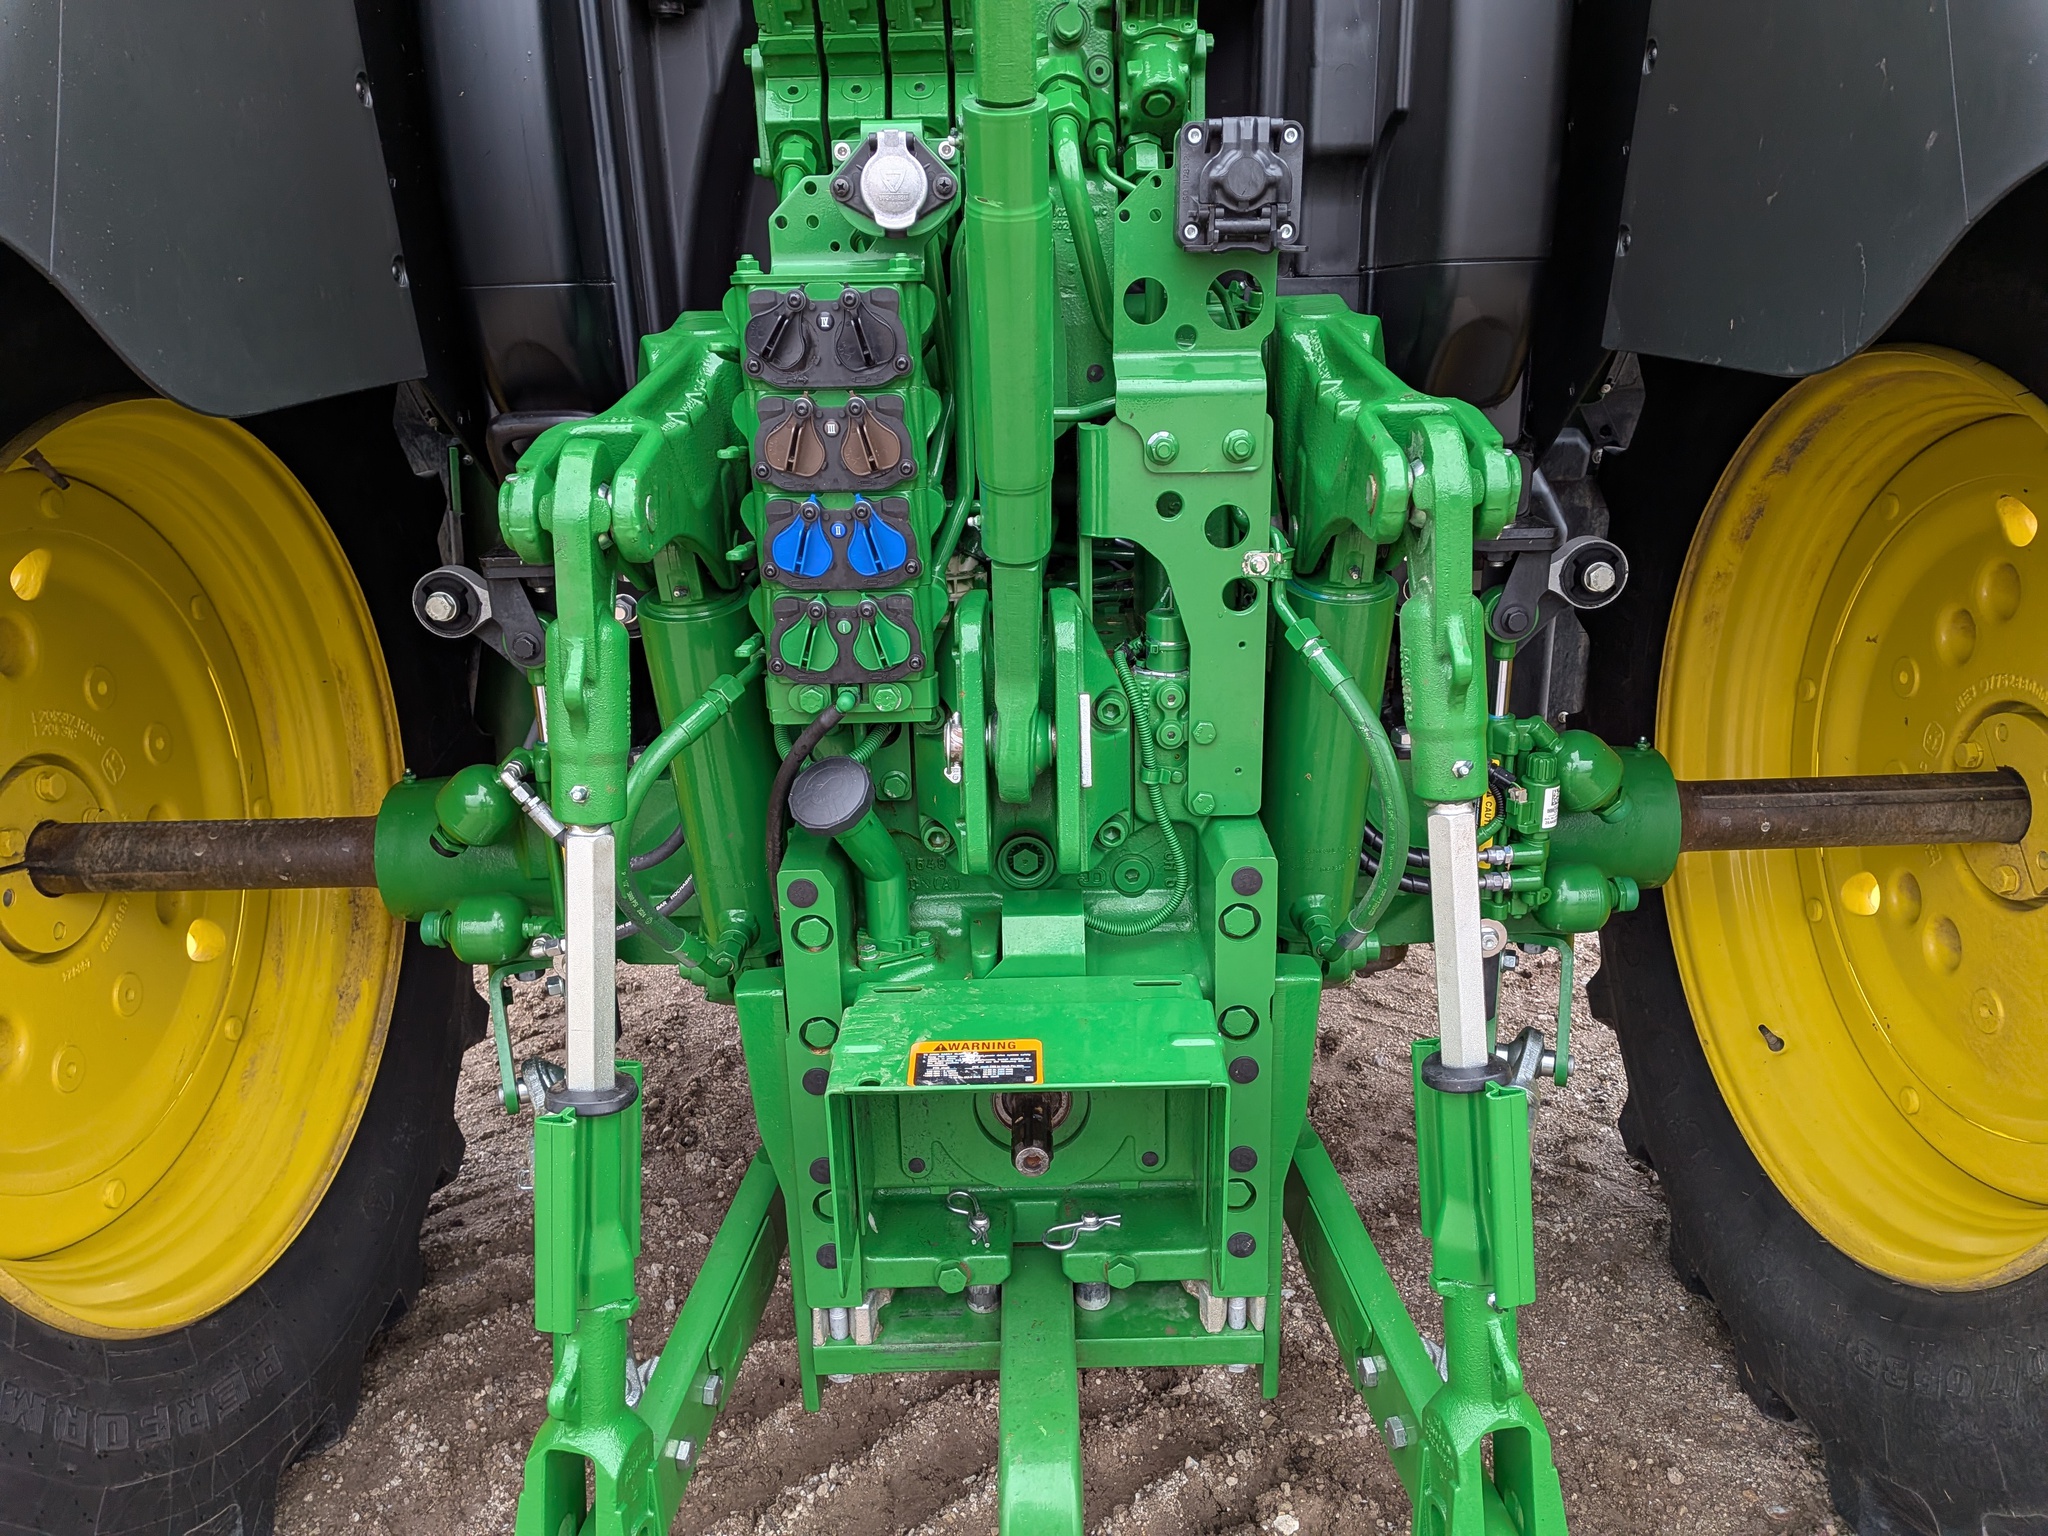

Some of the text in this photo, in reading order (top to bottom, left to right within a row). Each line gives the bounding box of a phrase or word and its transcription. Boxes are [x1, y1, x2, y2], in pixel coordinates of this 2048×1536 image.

[820, 316, 830, 328] IV
[827, 423, 836, 434] III
[1484, 801, 1493, 827] CAUT
[948, 1041, 1016, 1051] WARNING
